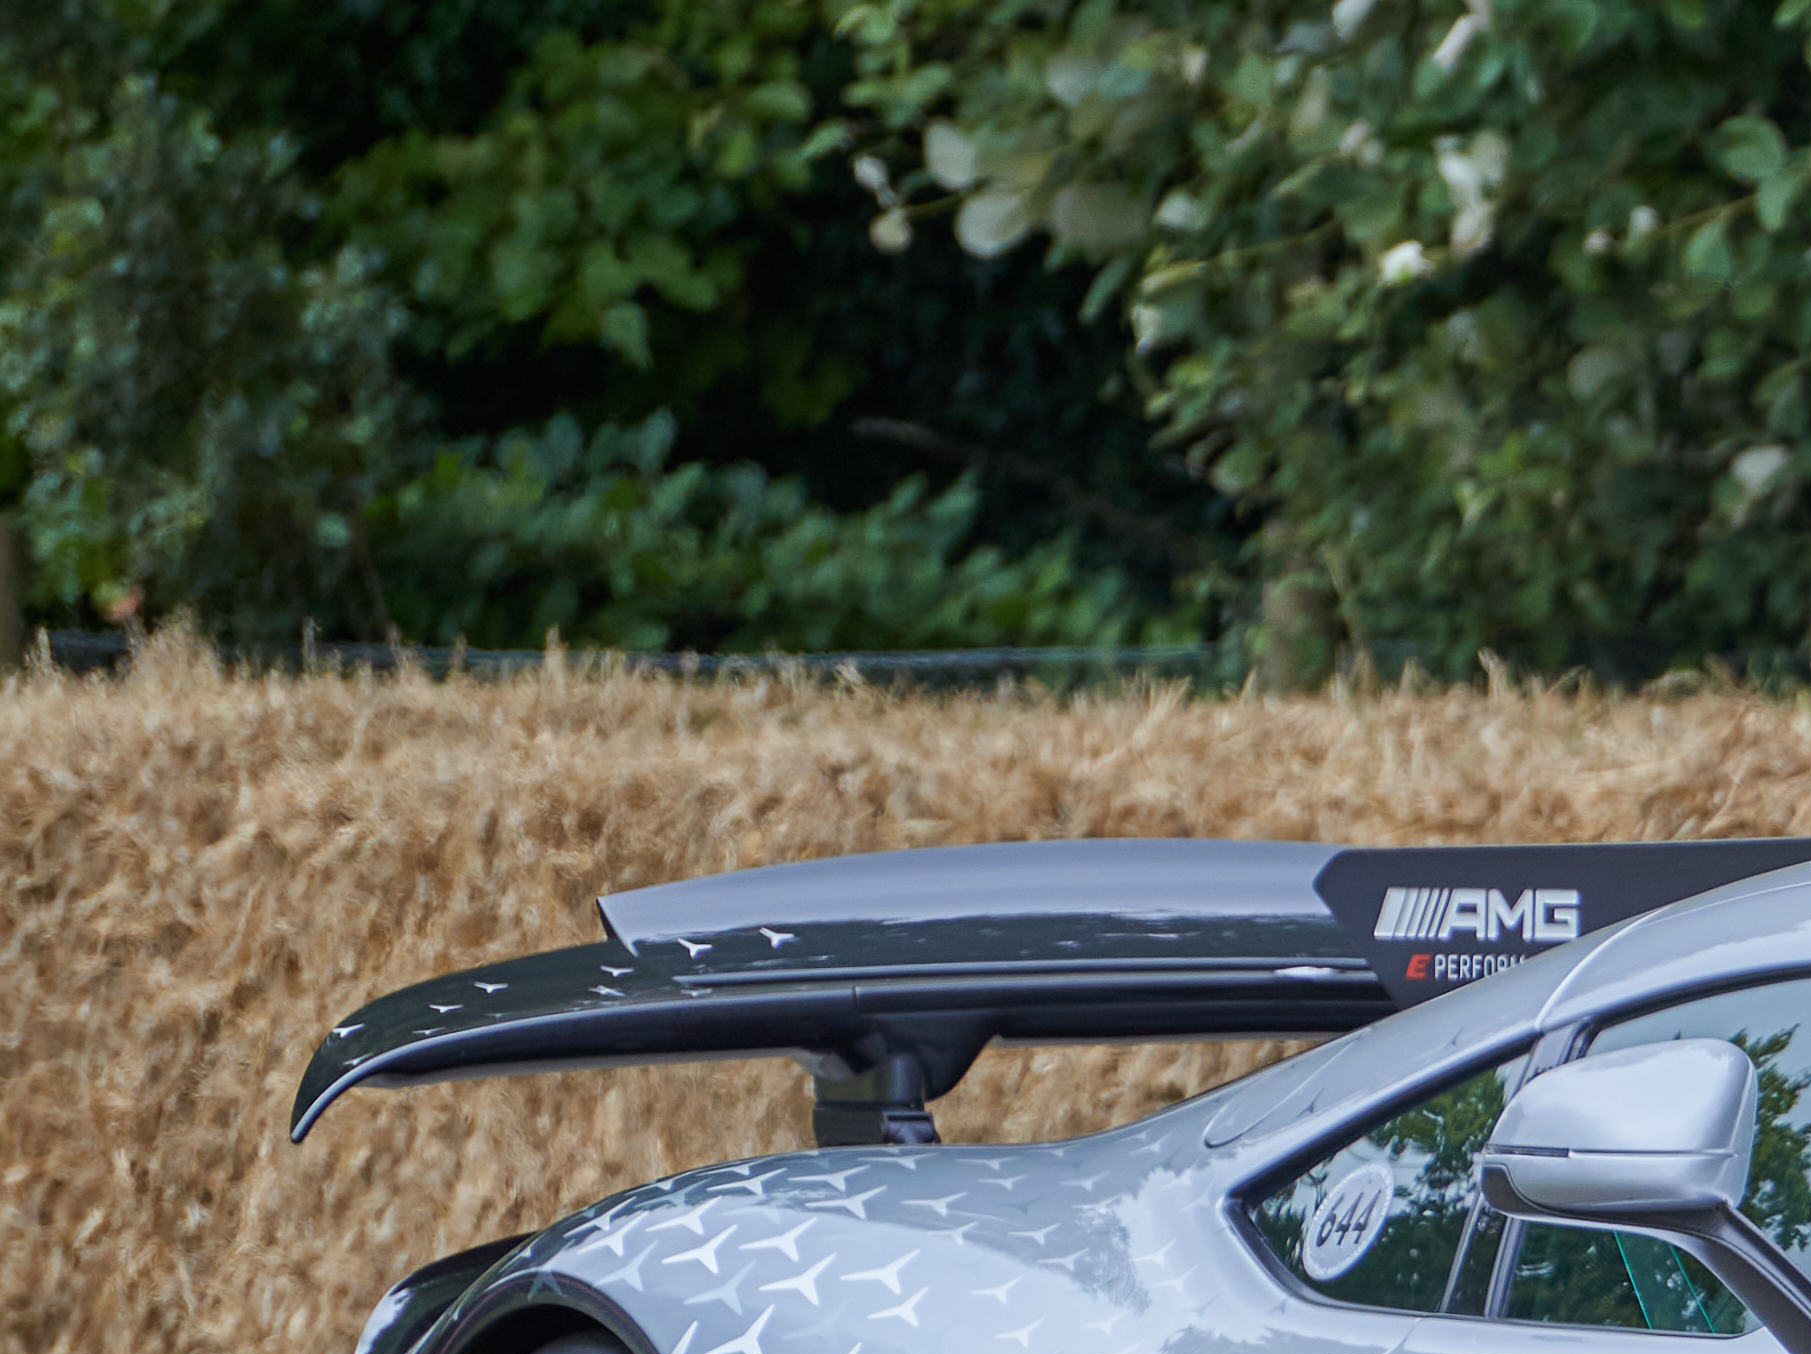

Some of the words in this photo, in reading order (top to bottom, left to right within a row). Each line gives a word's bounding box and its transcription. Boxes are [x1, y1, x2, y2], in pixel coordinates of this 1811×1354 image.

[1437, 888, 1581, 942] AMG
[1405, 953, 1432, 980] E
[1315, 1189, 1382, 1247] 644
